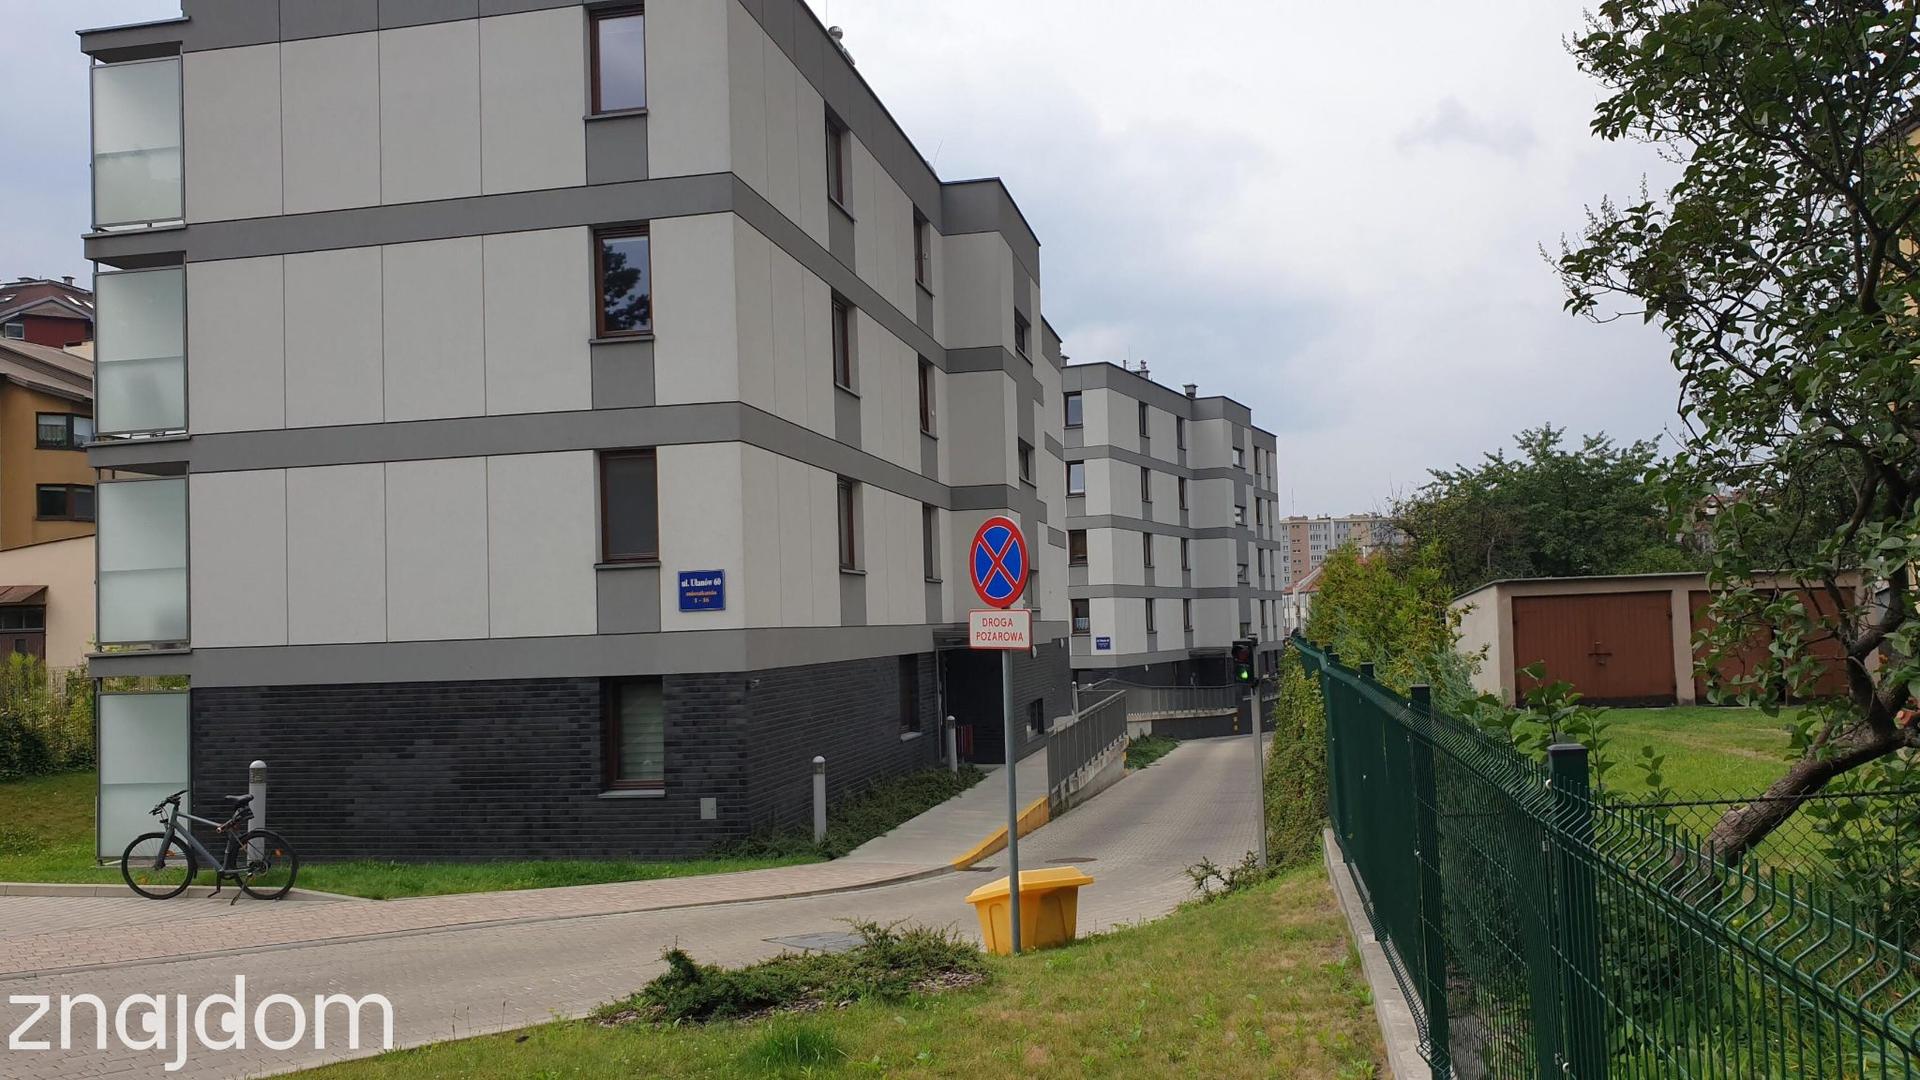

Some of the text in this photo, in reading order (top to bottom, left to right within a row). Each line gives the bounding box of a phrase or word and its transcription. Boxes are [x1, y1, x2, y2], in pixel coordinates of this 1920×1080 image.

[681, 578, 690, 587] ul.
[713, 577, 721, 586] 60
[982, 618, 1013, 627] DROGA
